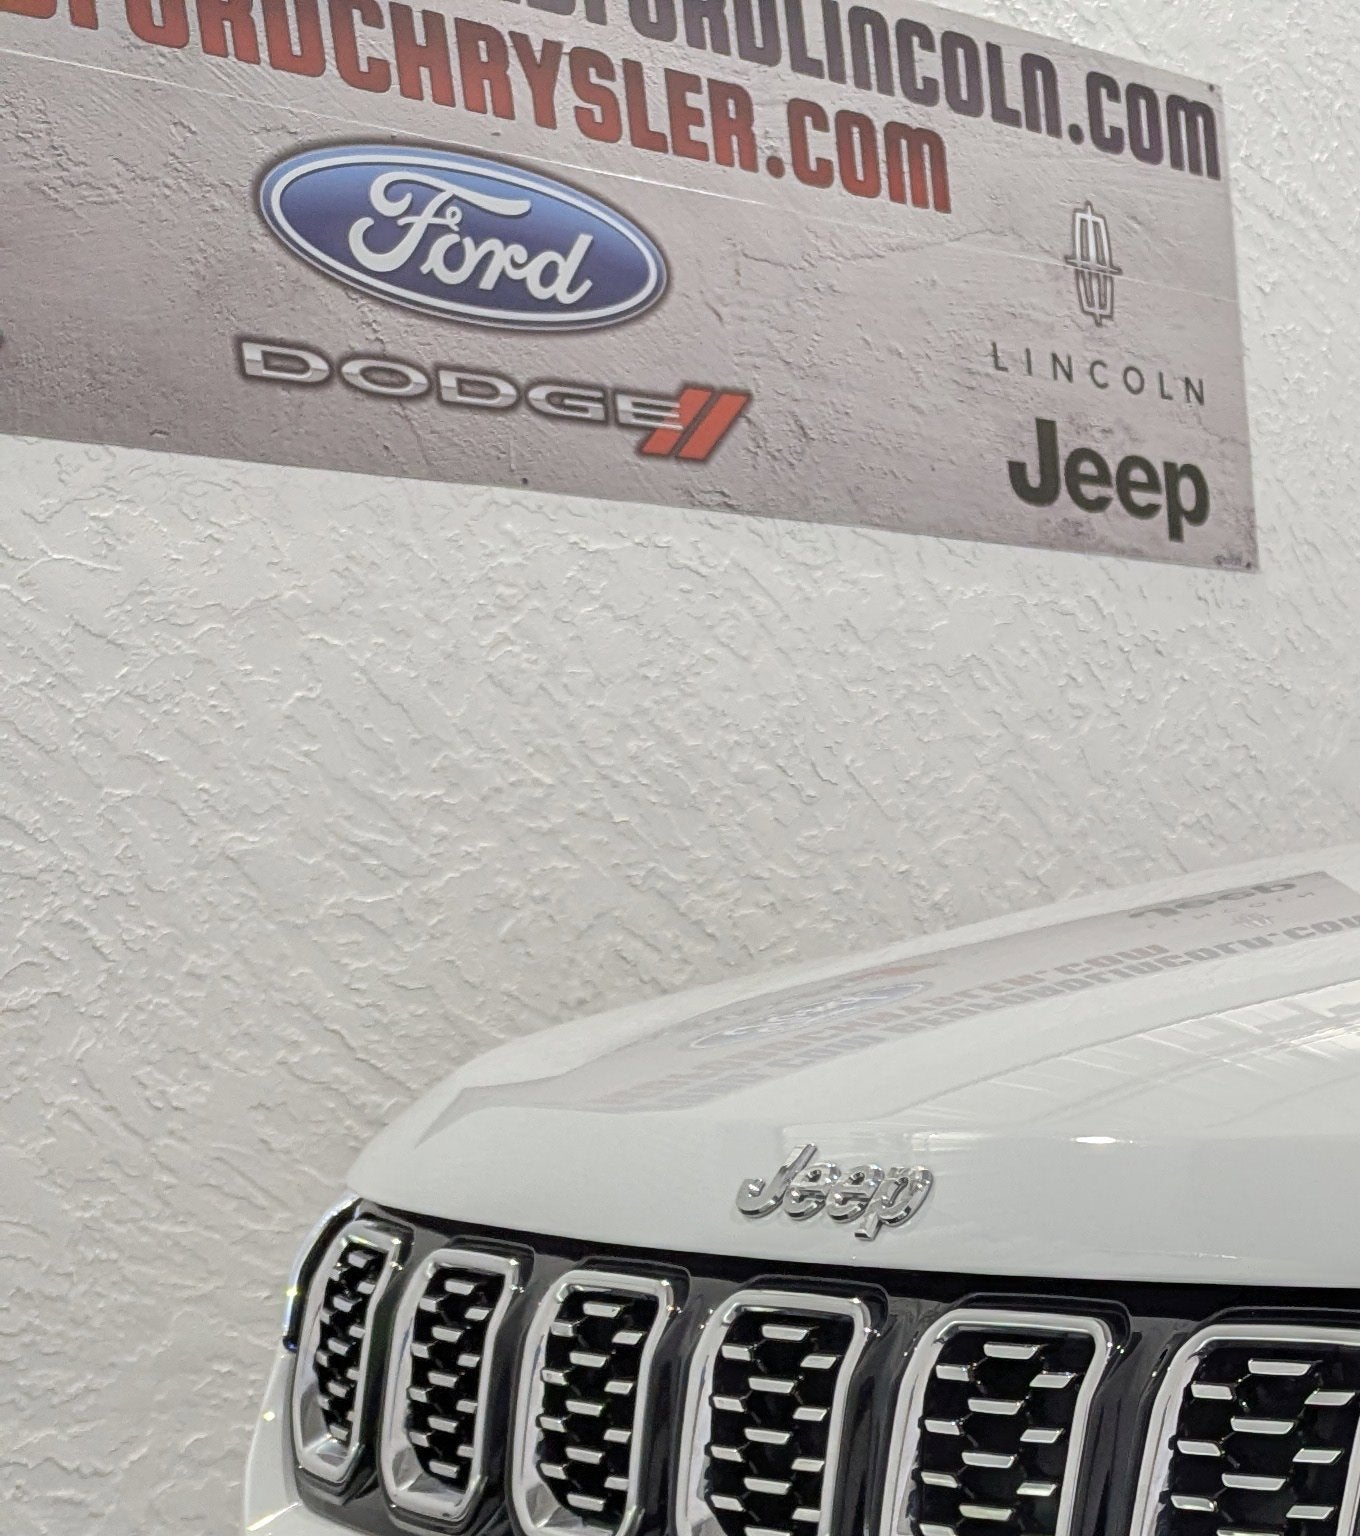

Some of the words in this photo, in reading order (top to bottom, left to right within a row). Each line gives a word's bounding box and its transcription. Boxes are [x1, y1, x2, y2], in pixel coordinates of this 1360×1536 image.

[348, 171, 593, 304] Ford
[240, 339, 685, 431] DODGE
[991, 341, 1206, 407] LINCOLN
[1007, 417, 1211, 542] Jeep
[734, 1142, 935, 1242] Jeep
